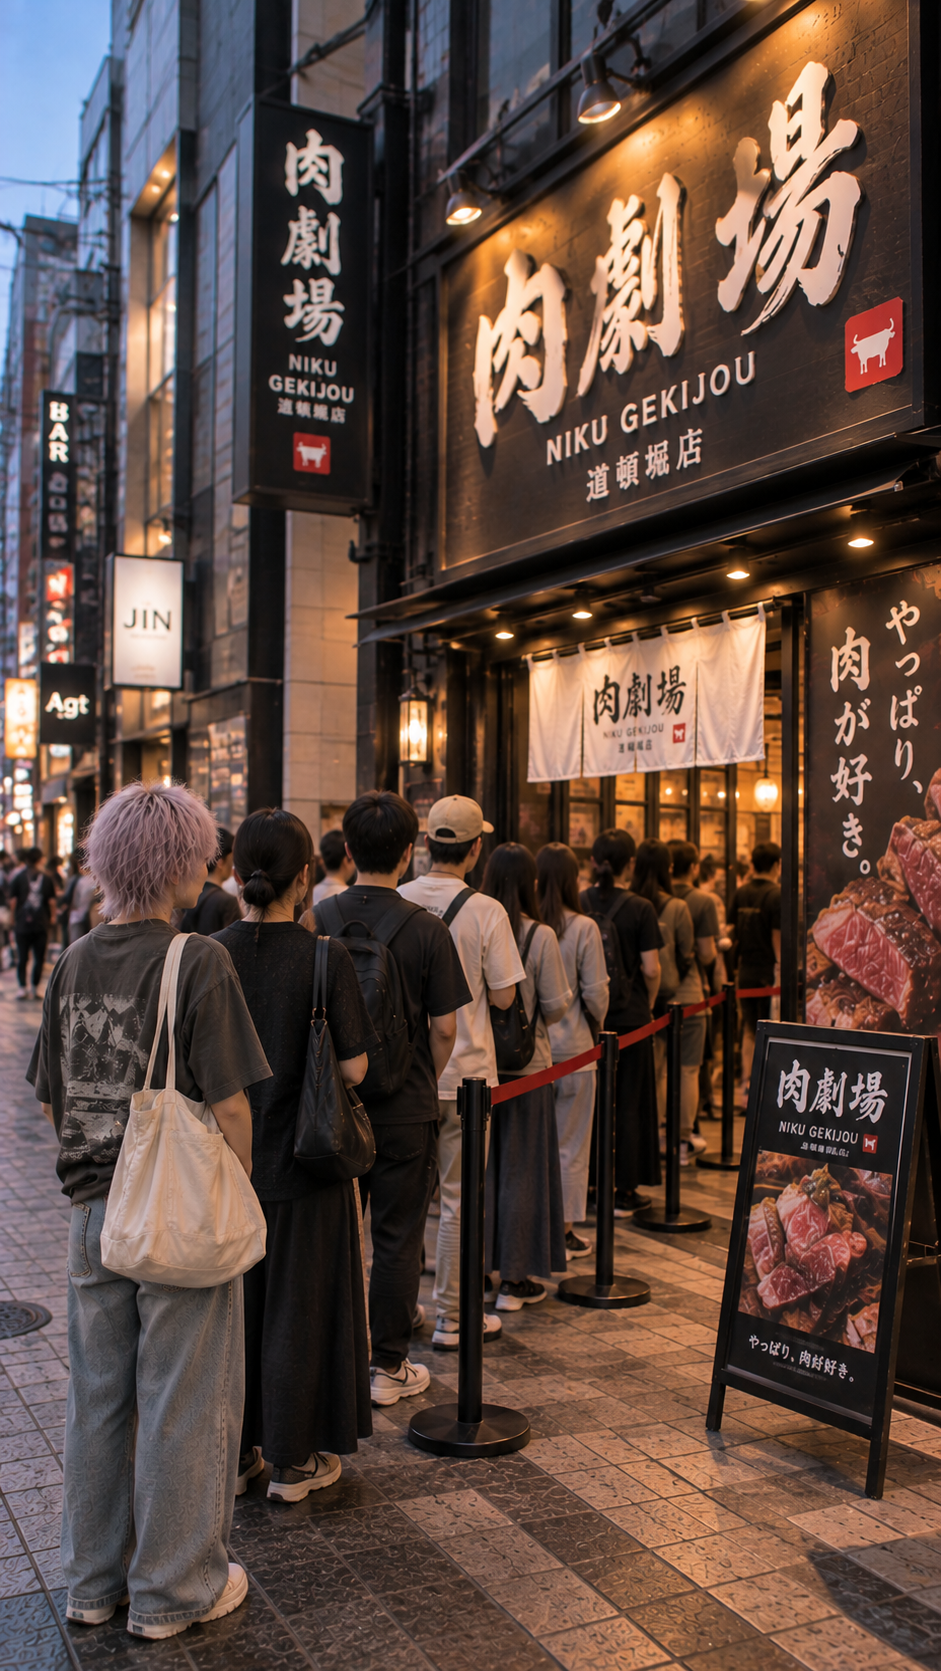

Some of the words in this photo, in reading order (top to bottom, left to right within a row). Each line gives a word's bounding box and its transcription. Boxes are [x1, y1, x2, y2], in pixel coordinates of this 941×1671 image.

[280, 128, 345, 346] 肉劇場
[472, 60, 863, 447] 肉劇場
[268, 374, 355, 404] GEKIJOU
[288, 353, 337, 377] NIKU
[49, 401, 69, 463] BAR
[546, 415, 608, 466] NIKU
[620, 351, 756, 434] GEKIJOU
[586, 428, 703, 502] 道頓堀店
[123, 608, 171, 631] JIN
[593, 665, 687, 725] 肉劇場
[885, 600, 923, 794] やっぱり、
[830, 626, 873, 875] 肉が好き。
[777, 1059, 888, 1123] 肉劇場
[779, 1121, 806, 1136] NIKU
[809, 1125, 859, 1145] GEKIJOU
